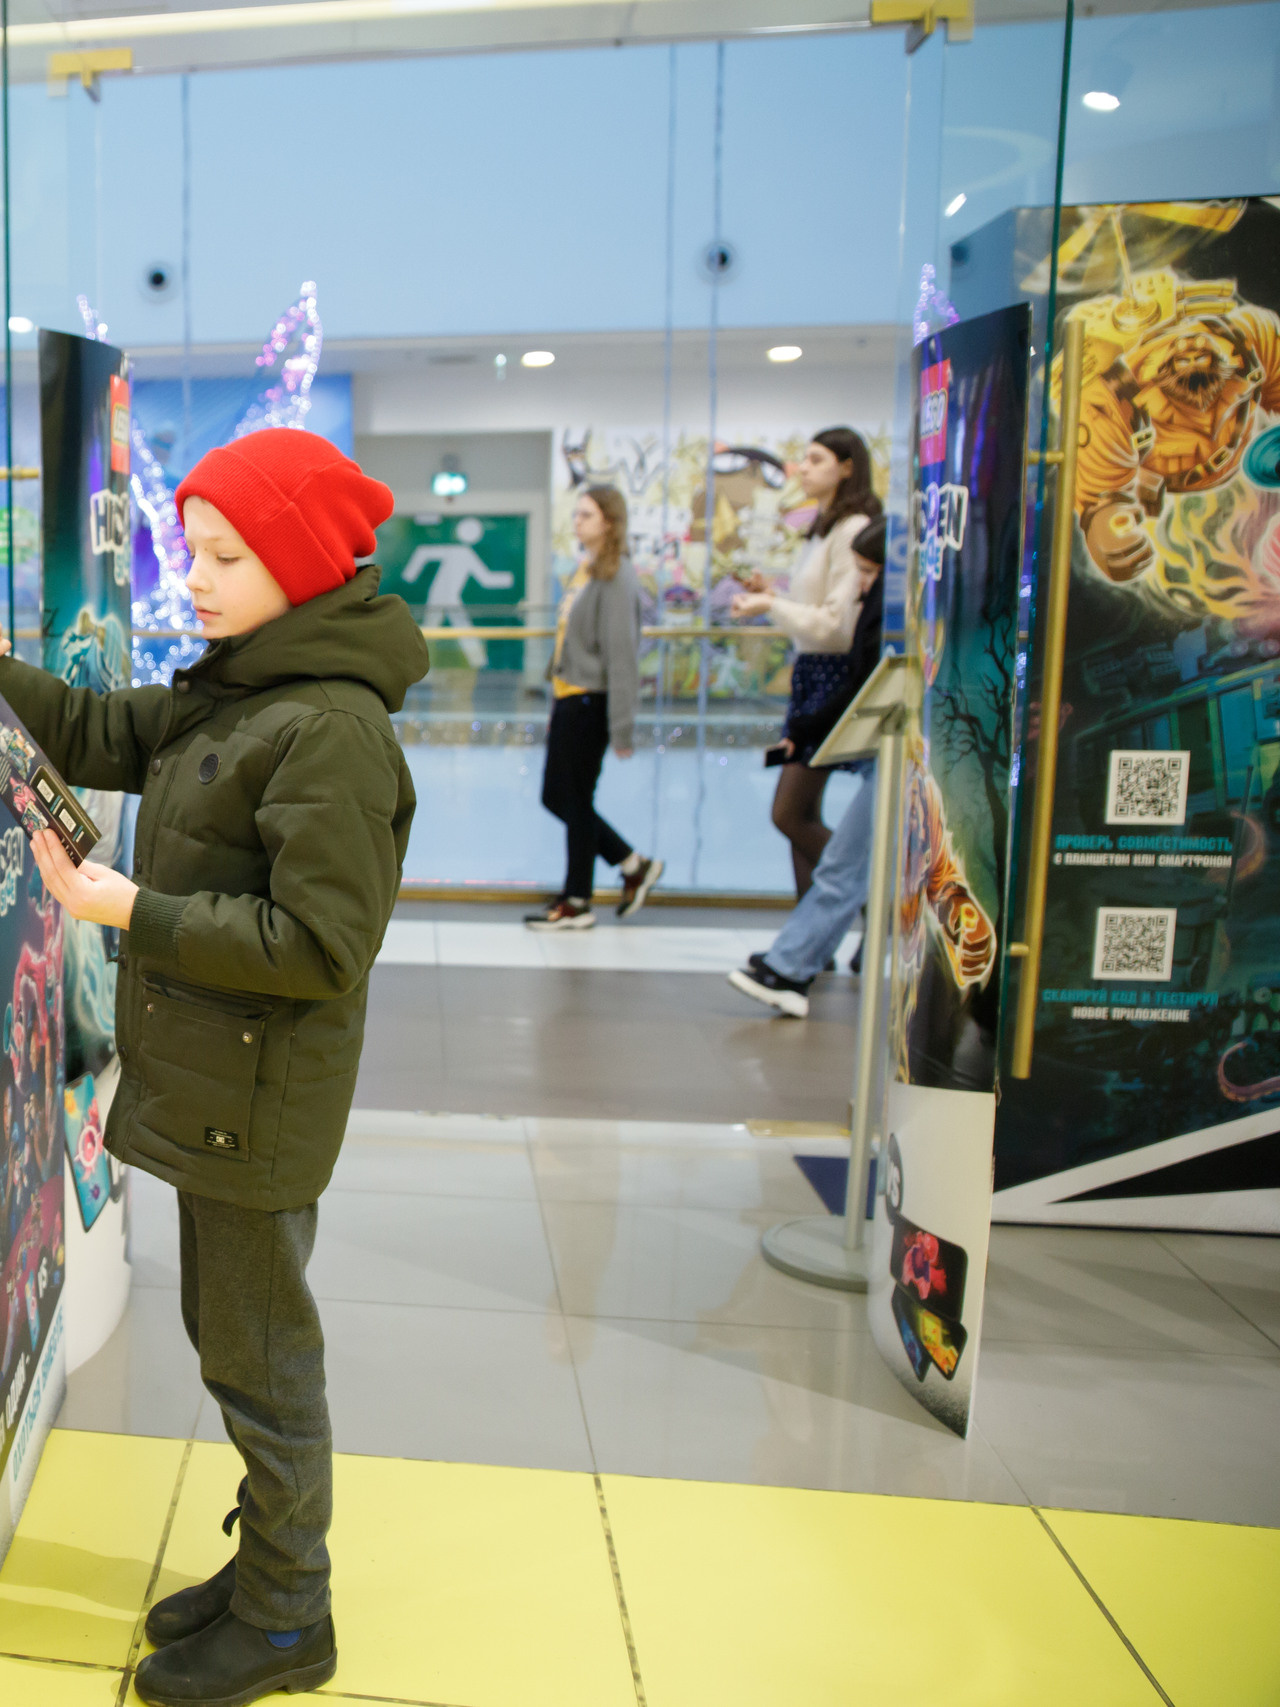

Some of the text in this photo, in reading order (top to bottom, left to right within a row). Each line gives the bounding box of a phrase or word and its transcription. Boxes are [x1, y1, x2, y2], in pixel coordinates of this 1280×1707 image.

[1055, 834, 1232, 851] ПРОВЕРЬ СОВМЕСТИМОСТЬ
[1065, 852, 1130, 866] ПЛАНШЕТОМ
[1133, 854, 1155, 867] ИЛИ
[1158, 854, 1232, 868] СМАРТФОНОМ
[1042, 988, 1107, 1003] СКАНИРУЙ
[1111, 990, 1136, 1005] КОД
[1072, 1006, 1191, 1022] НОВОЕ ПРИЛОЖЕНИЕ
